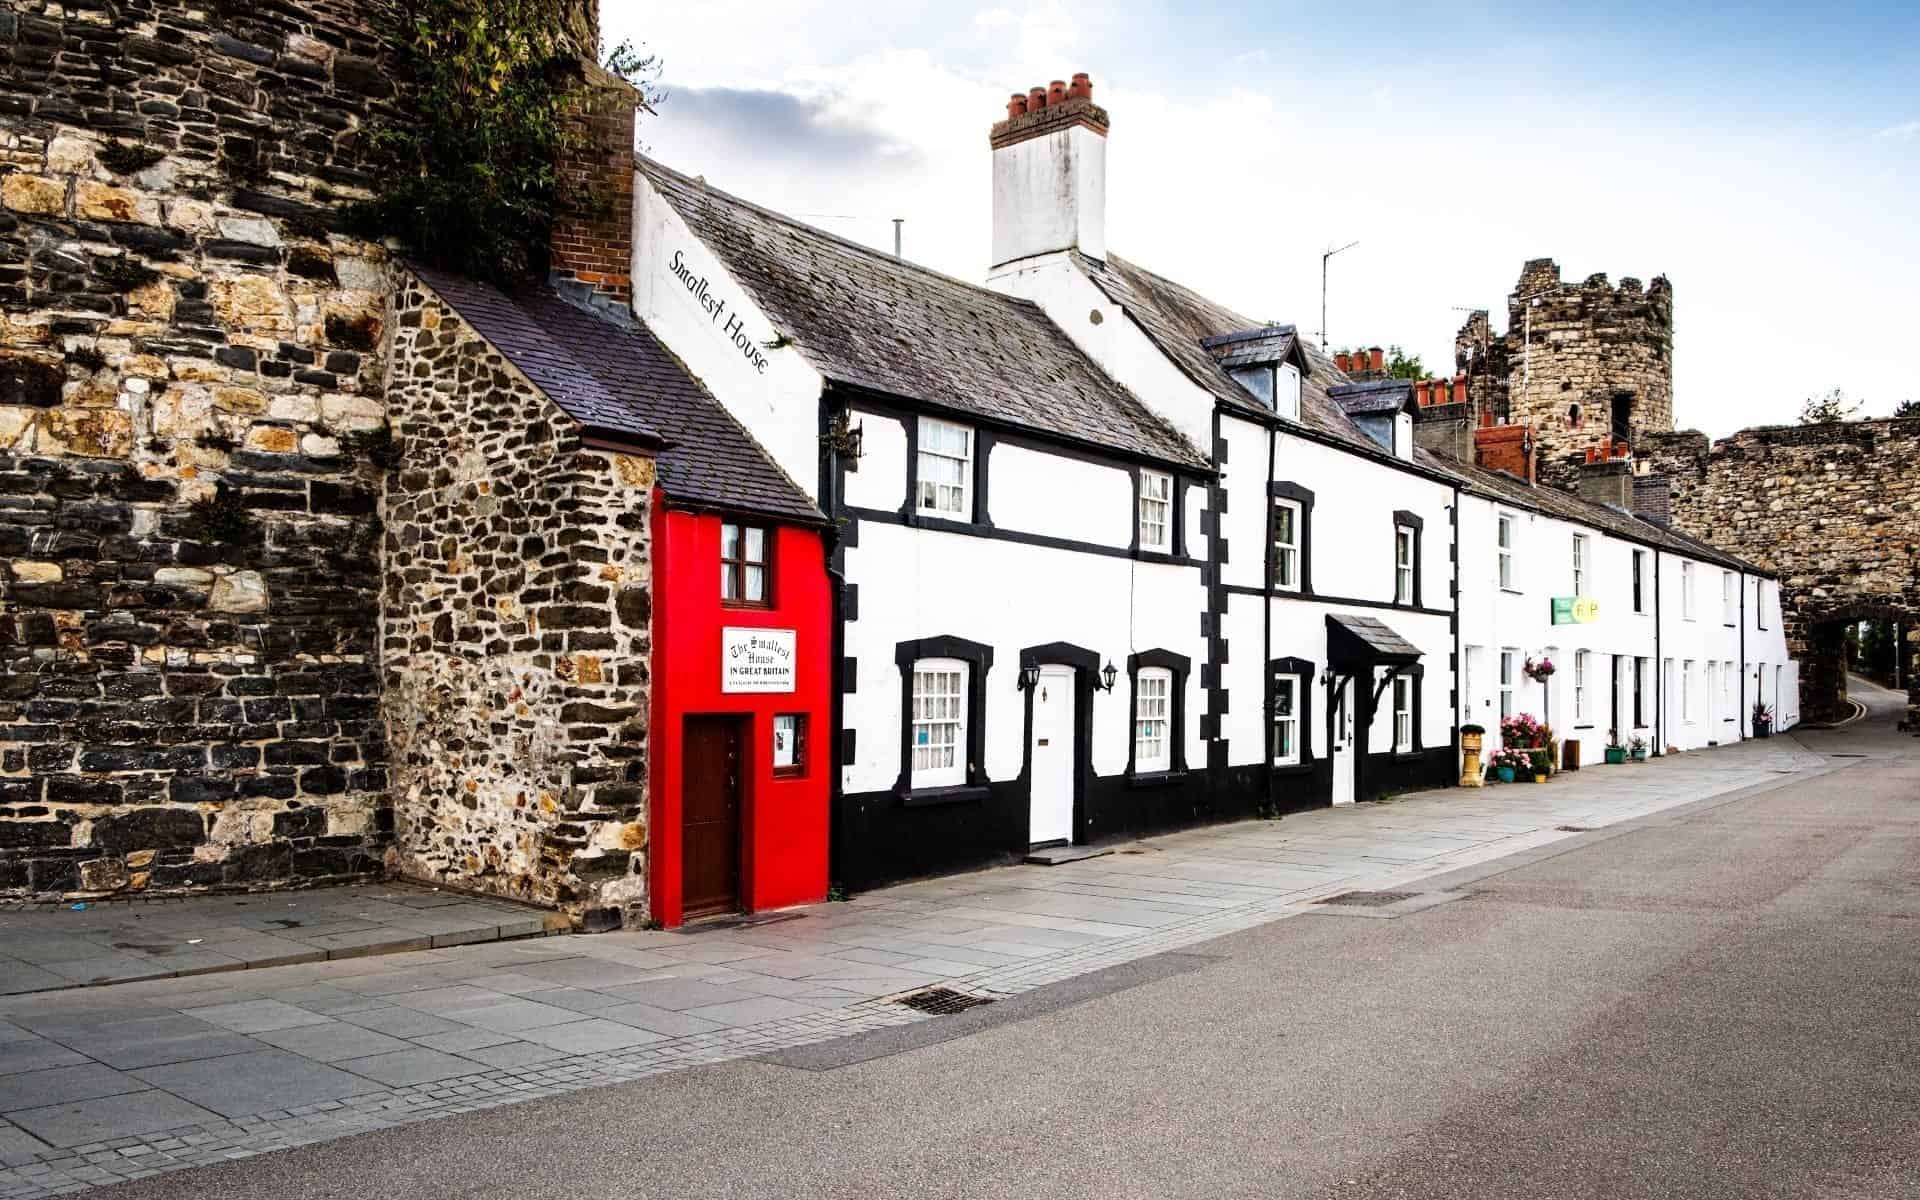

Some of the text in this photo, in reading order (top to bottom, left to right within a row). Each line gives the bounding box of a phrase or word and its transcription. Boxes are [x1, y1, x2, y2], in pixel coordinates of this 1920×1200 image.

[669, 250, 769, 374] Smallest House
[730, 644, 748, 658] The
[748, 651, 775, 664] House
[730, 666, 790, 675] IN GREAT BRITAIN
